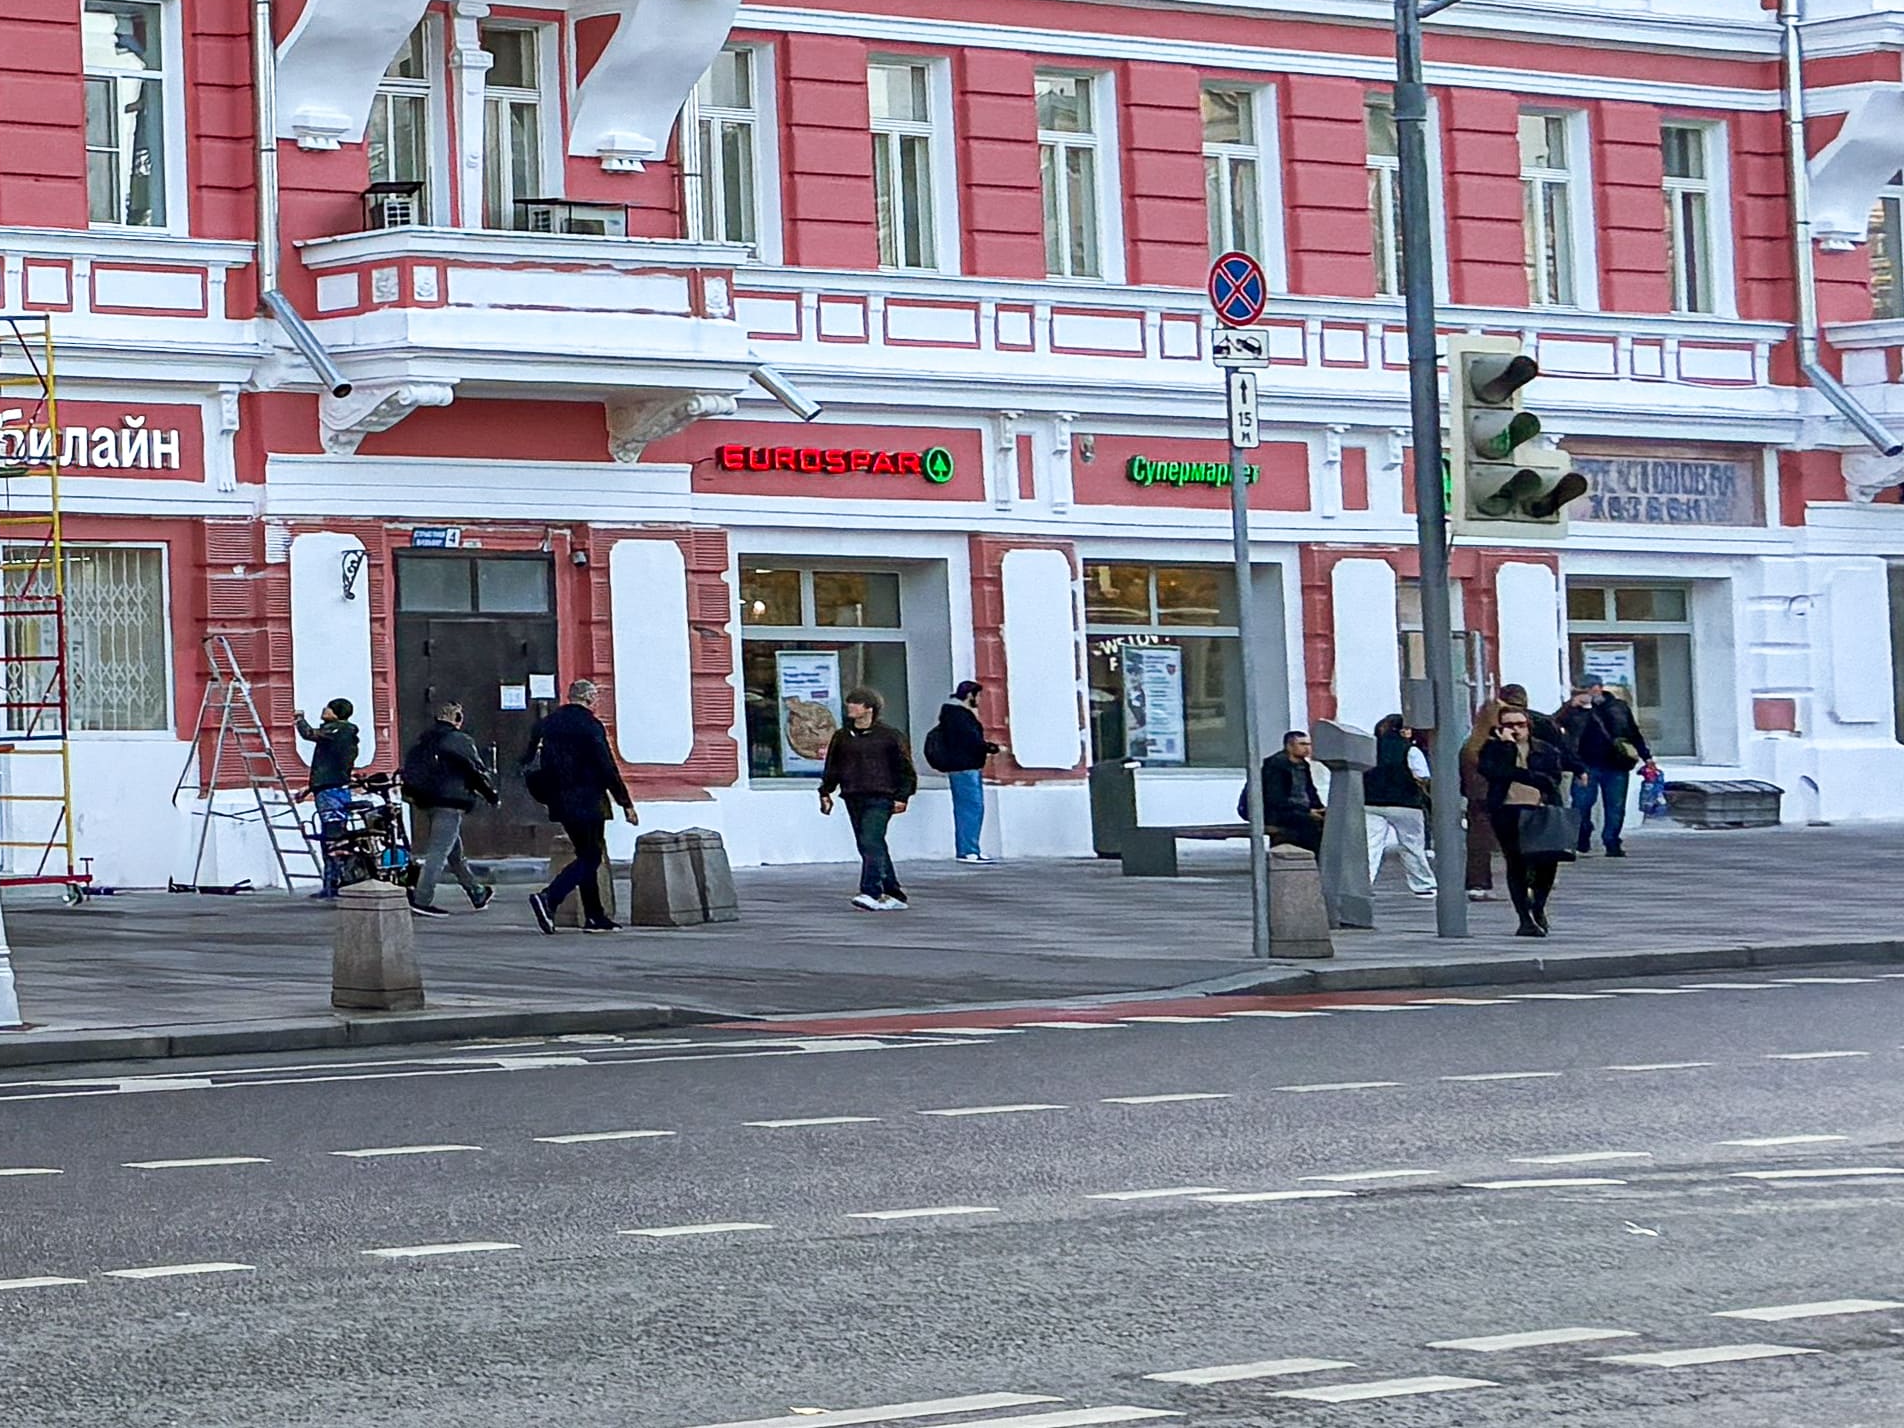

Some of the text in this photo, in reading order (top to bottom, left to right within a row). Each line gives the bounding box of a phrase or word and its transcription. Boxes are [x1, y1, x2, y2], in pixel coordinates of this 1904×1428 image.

[1238, 411, 1252, 427] 15
[718, 443, 924, 476] EUROSPAR
[1129, 455, 1261, 487] Супермарет
[448, 531, 456, 544] 4
